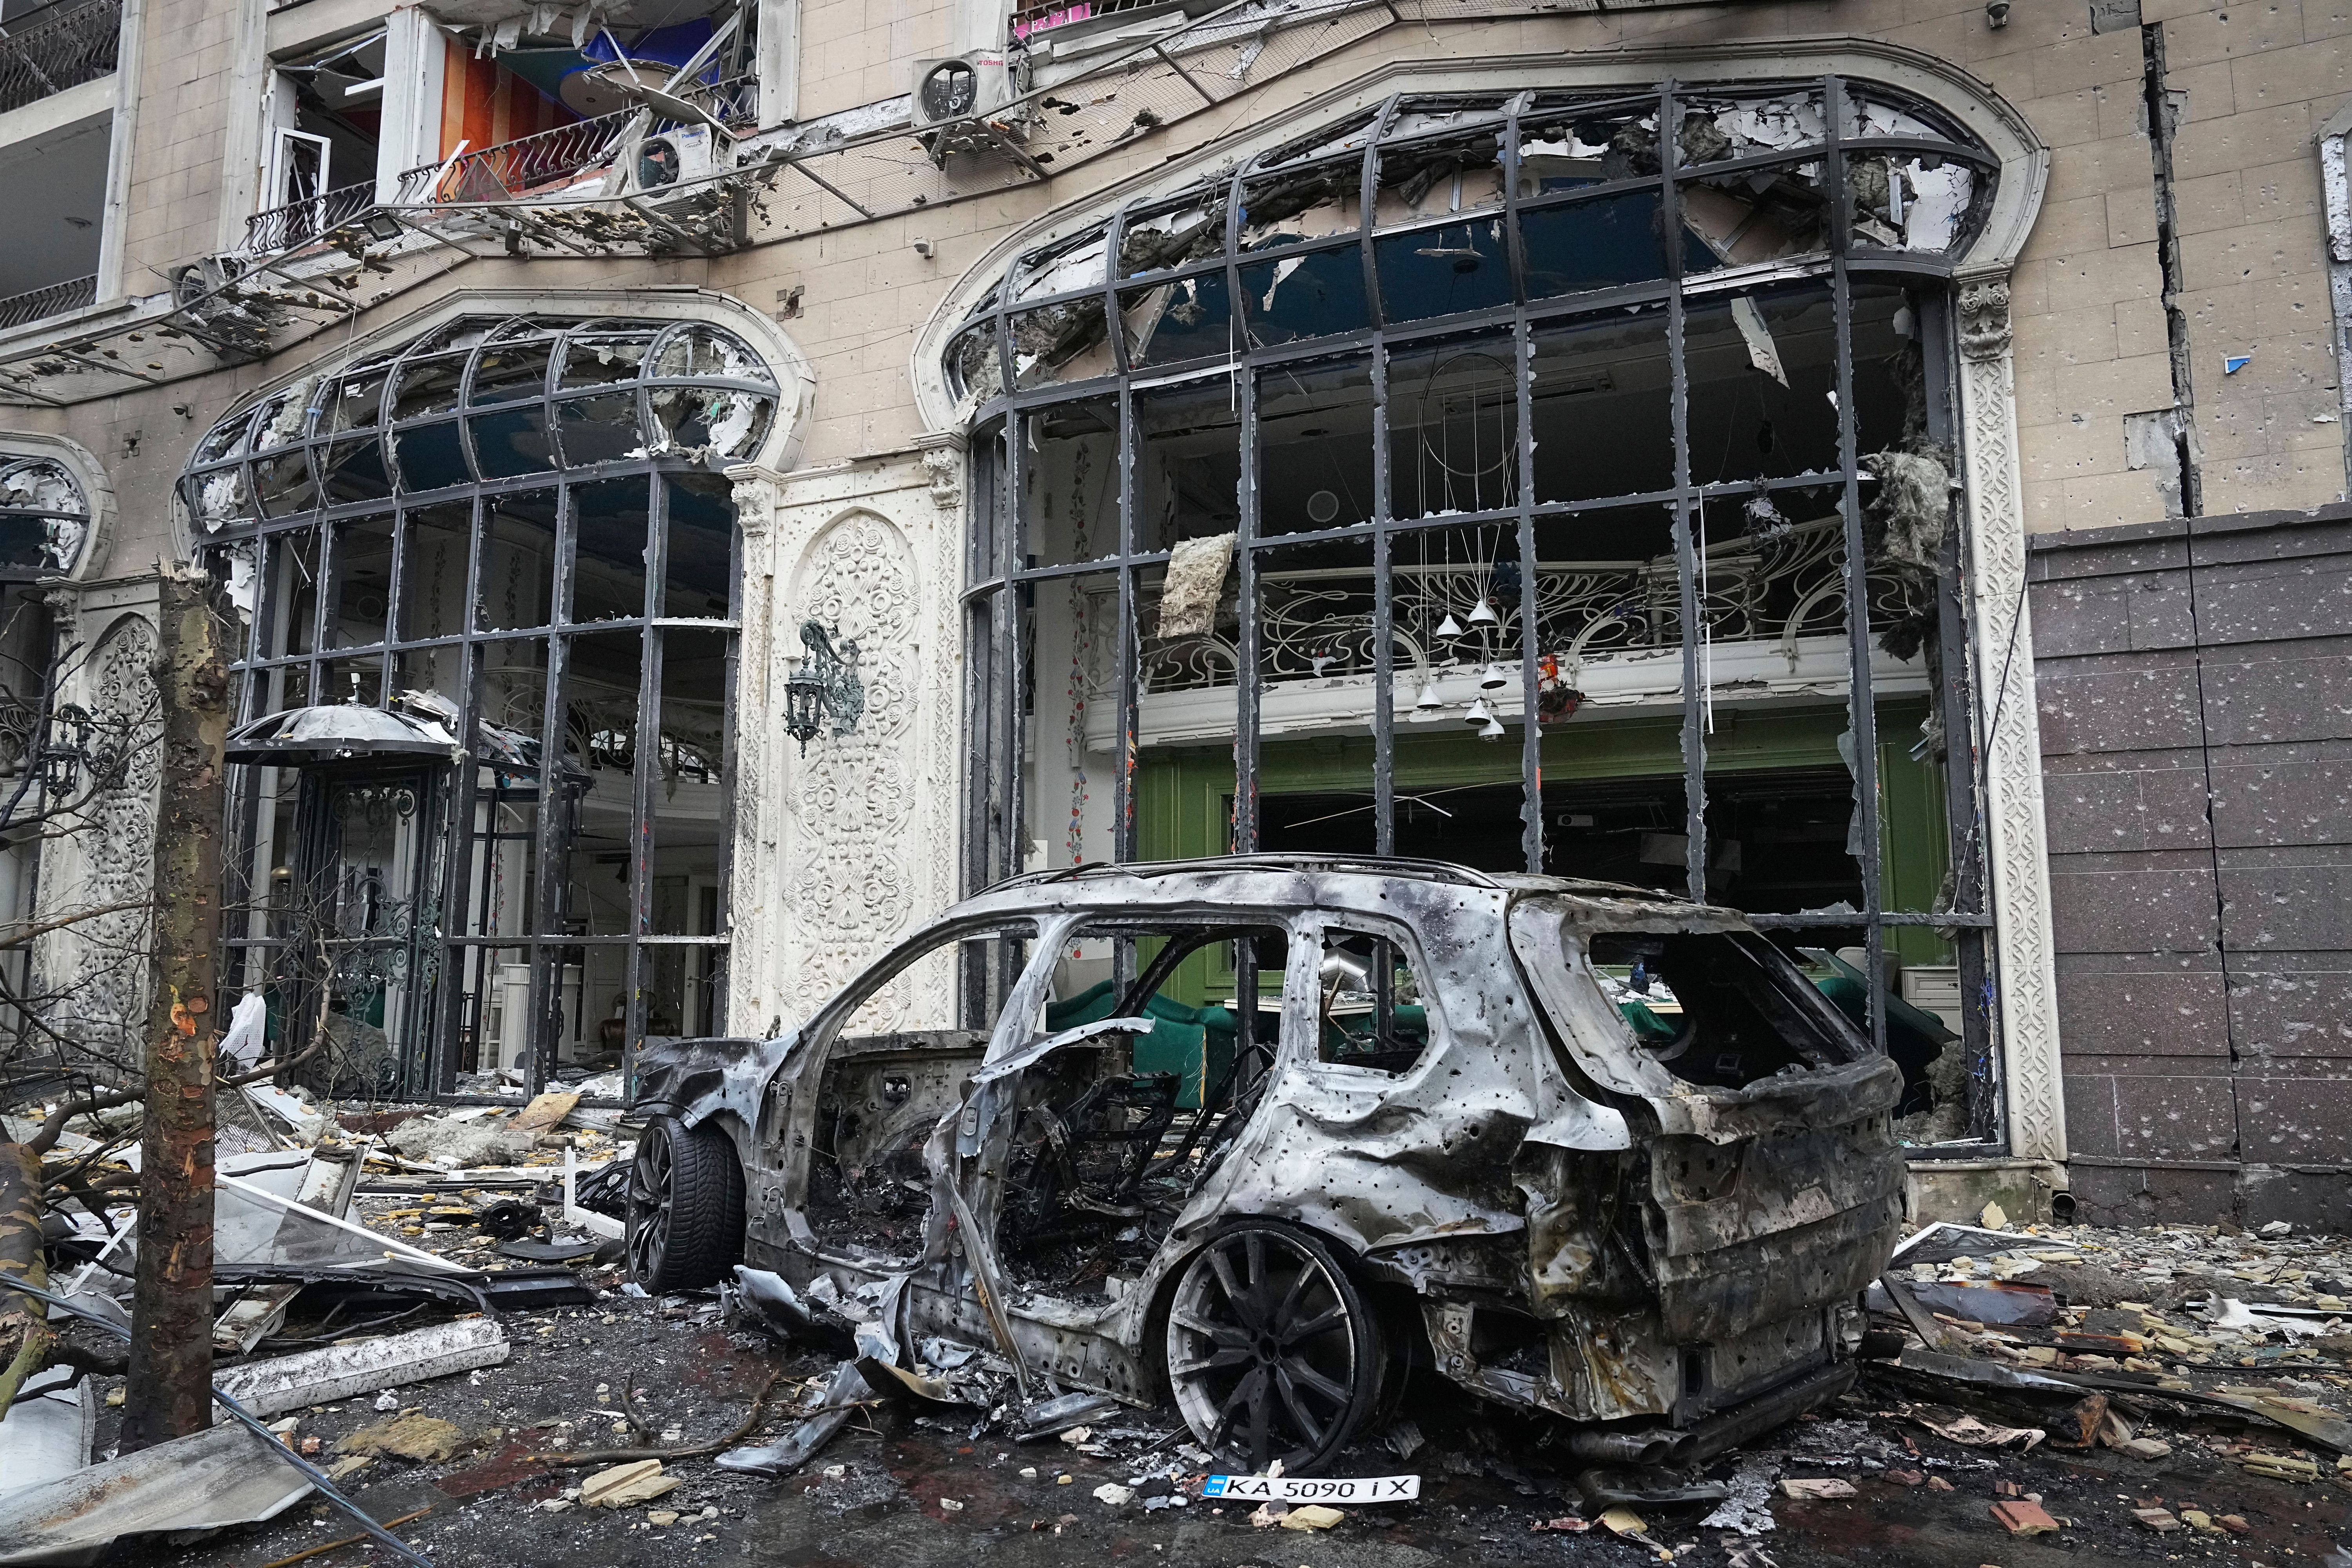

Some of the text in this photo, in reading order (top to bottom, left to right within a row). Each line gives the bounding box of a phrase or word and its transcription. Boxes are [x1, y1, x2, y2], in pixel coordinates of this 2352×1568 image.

[682, 130, 705, 138] Panasonic
[1227, 1480, 1271, 1495] KA
[1283, 1483, 1355, 1497] 5090
